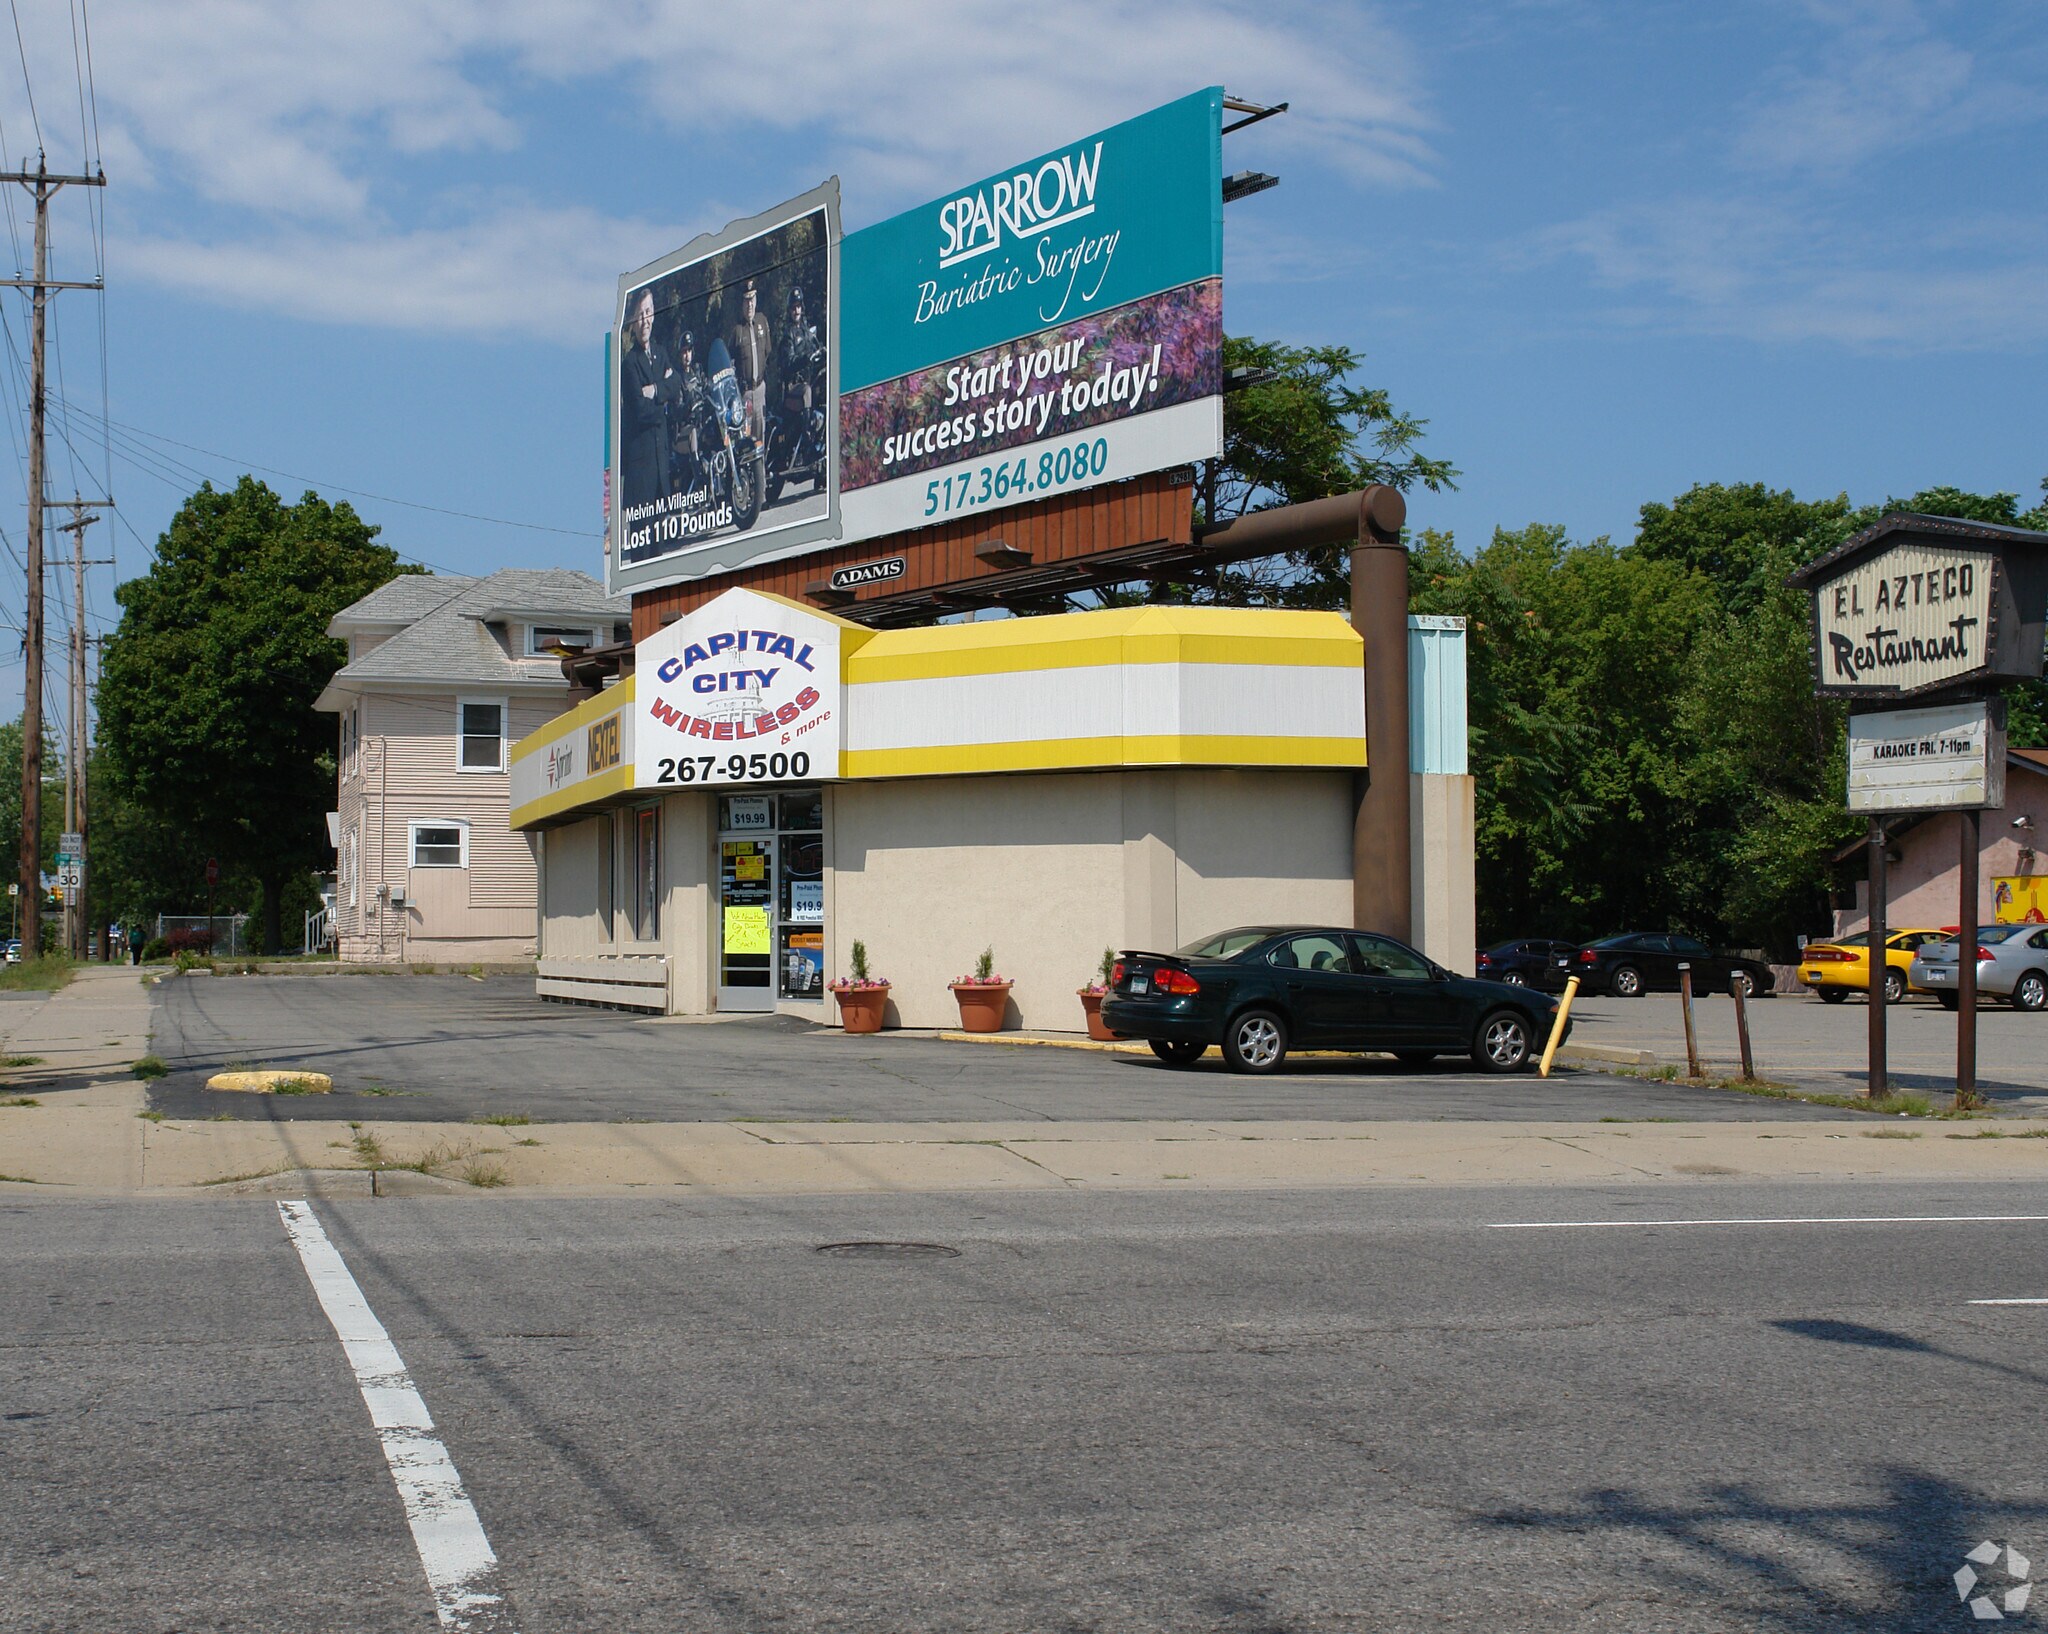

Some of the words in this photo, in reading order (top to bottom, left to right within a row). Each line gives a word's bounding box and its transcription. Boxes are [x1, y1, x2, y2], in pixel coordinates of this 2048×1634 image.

[940, 141, 1104, 259] SPARROW
[914, 258, 1022, 324] Bariatric
[1027, 229, 1121, 323] Surgery
[944, 356, 1013, 406] Start
[1016, 337, 1086, 396] your
[882, 412, 977, 465] success
[981, 390, 1056, 435] story
[1061, 343, 1162, 415] today!
[625, 503, 655, 523] Melvin
[655, 498, 667, 515] M.
[667, 484, 707, 511] Villarreal
[924, 438, 1109, 517] 517.364.8080
[623, 525, 651, 551] Lost
[653, 516, 678, 543] 110
[680, 501, 733, 536] Pounds
[836, 561, 901, 585] ADAMS
[1834, 584, 1864, 618] EL
[1875, 563, 1974, 613] AZTECO
[657, 630, 815, 684] CAPITAL
[1828, 614, 1978, 681] Restaurant
[692, 667, 781, 694] CITY
[650, 686, 820, 741] WIRELESS
[780, 732, 791, 746] &
[796, 710, 831, 738] more
[587, 715, 620, 774] NEXTEL
[657, 751, 811, 784] 267-9500
[1873, 742, 1916, 759] KARAOKE
[1919, 741, 1936, 756] FRI.
[1940, 739, 1971, 755] 7-11pm
[734, 813, 765, 824] $19.99
[60, 875, 79, 885] 30
[796, 901, 823, 912] $19.9
